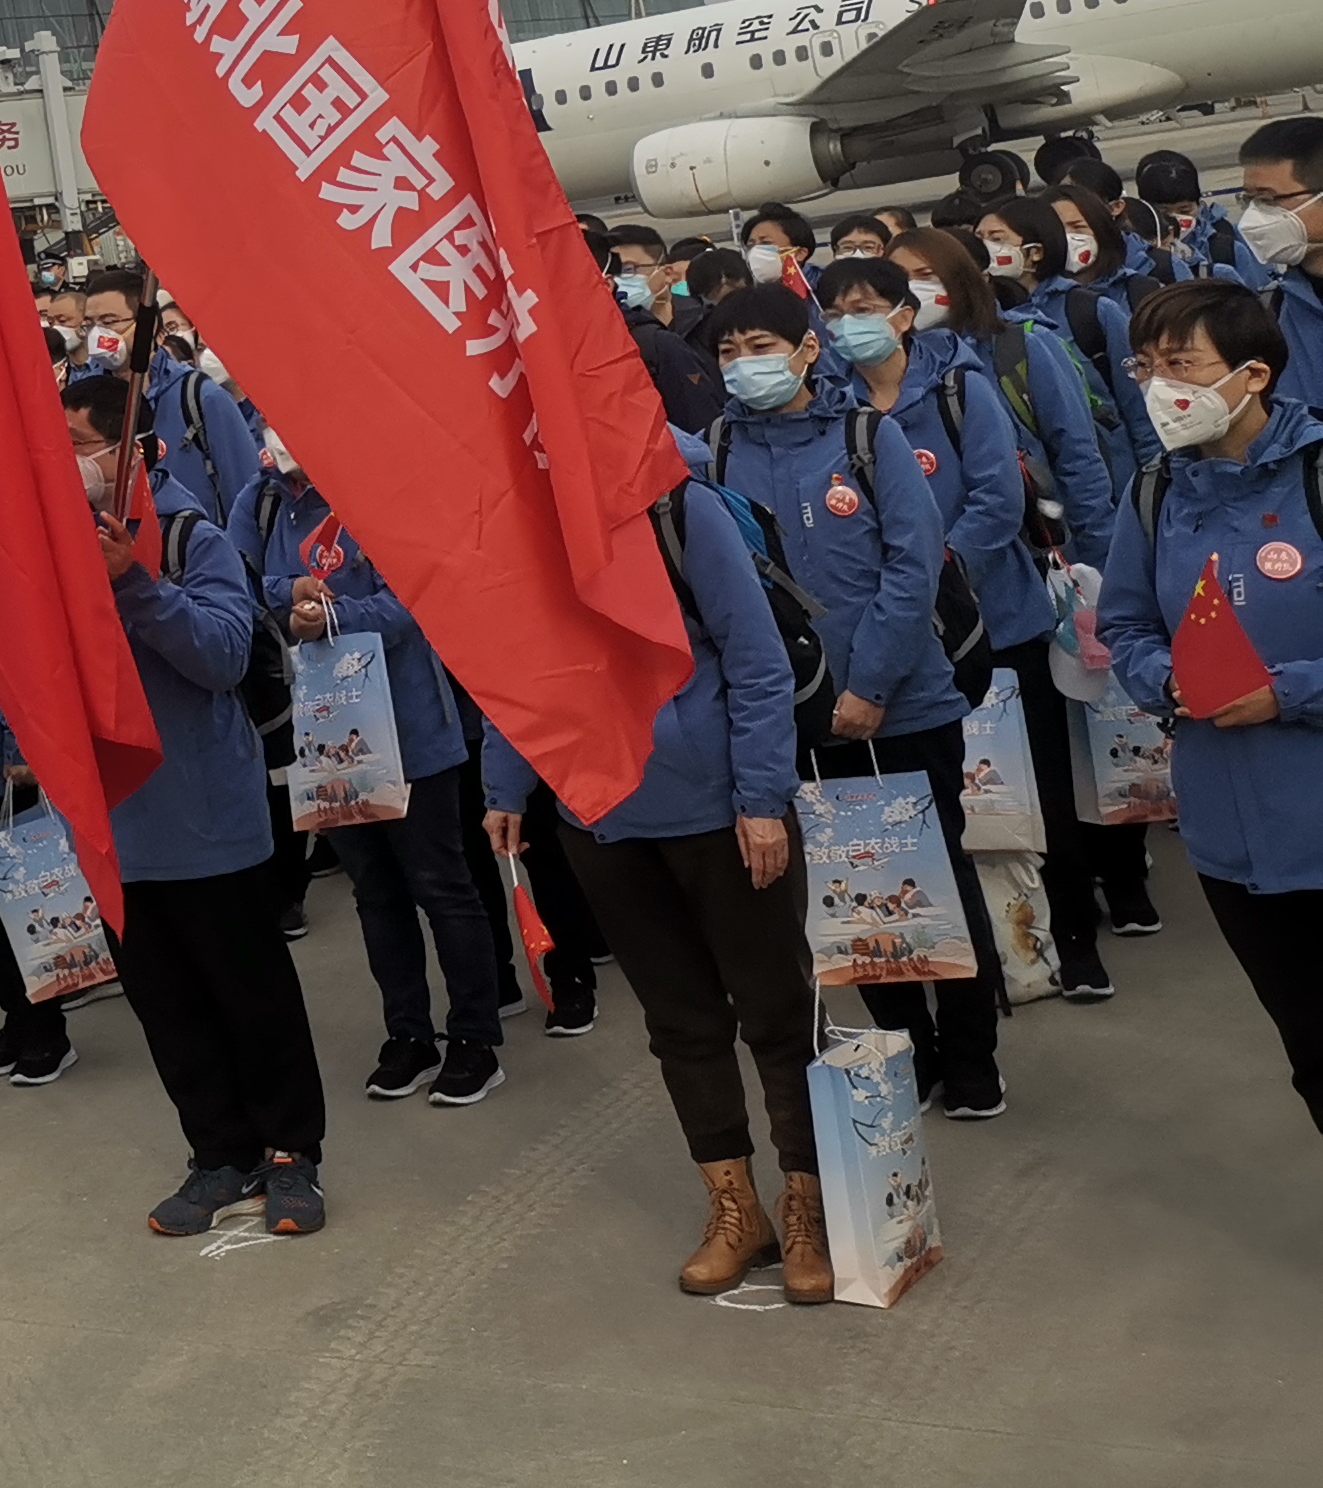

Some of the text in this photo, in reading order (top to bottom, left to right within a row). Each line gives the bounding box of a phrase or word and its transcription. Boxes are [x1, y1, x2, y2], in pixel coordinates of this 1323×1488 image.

[3, 163, 27, 177] OU
[811, 835, 918, 864] 致敬白衣战士
